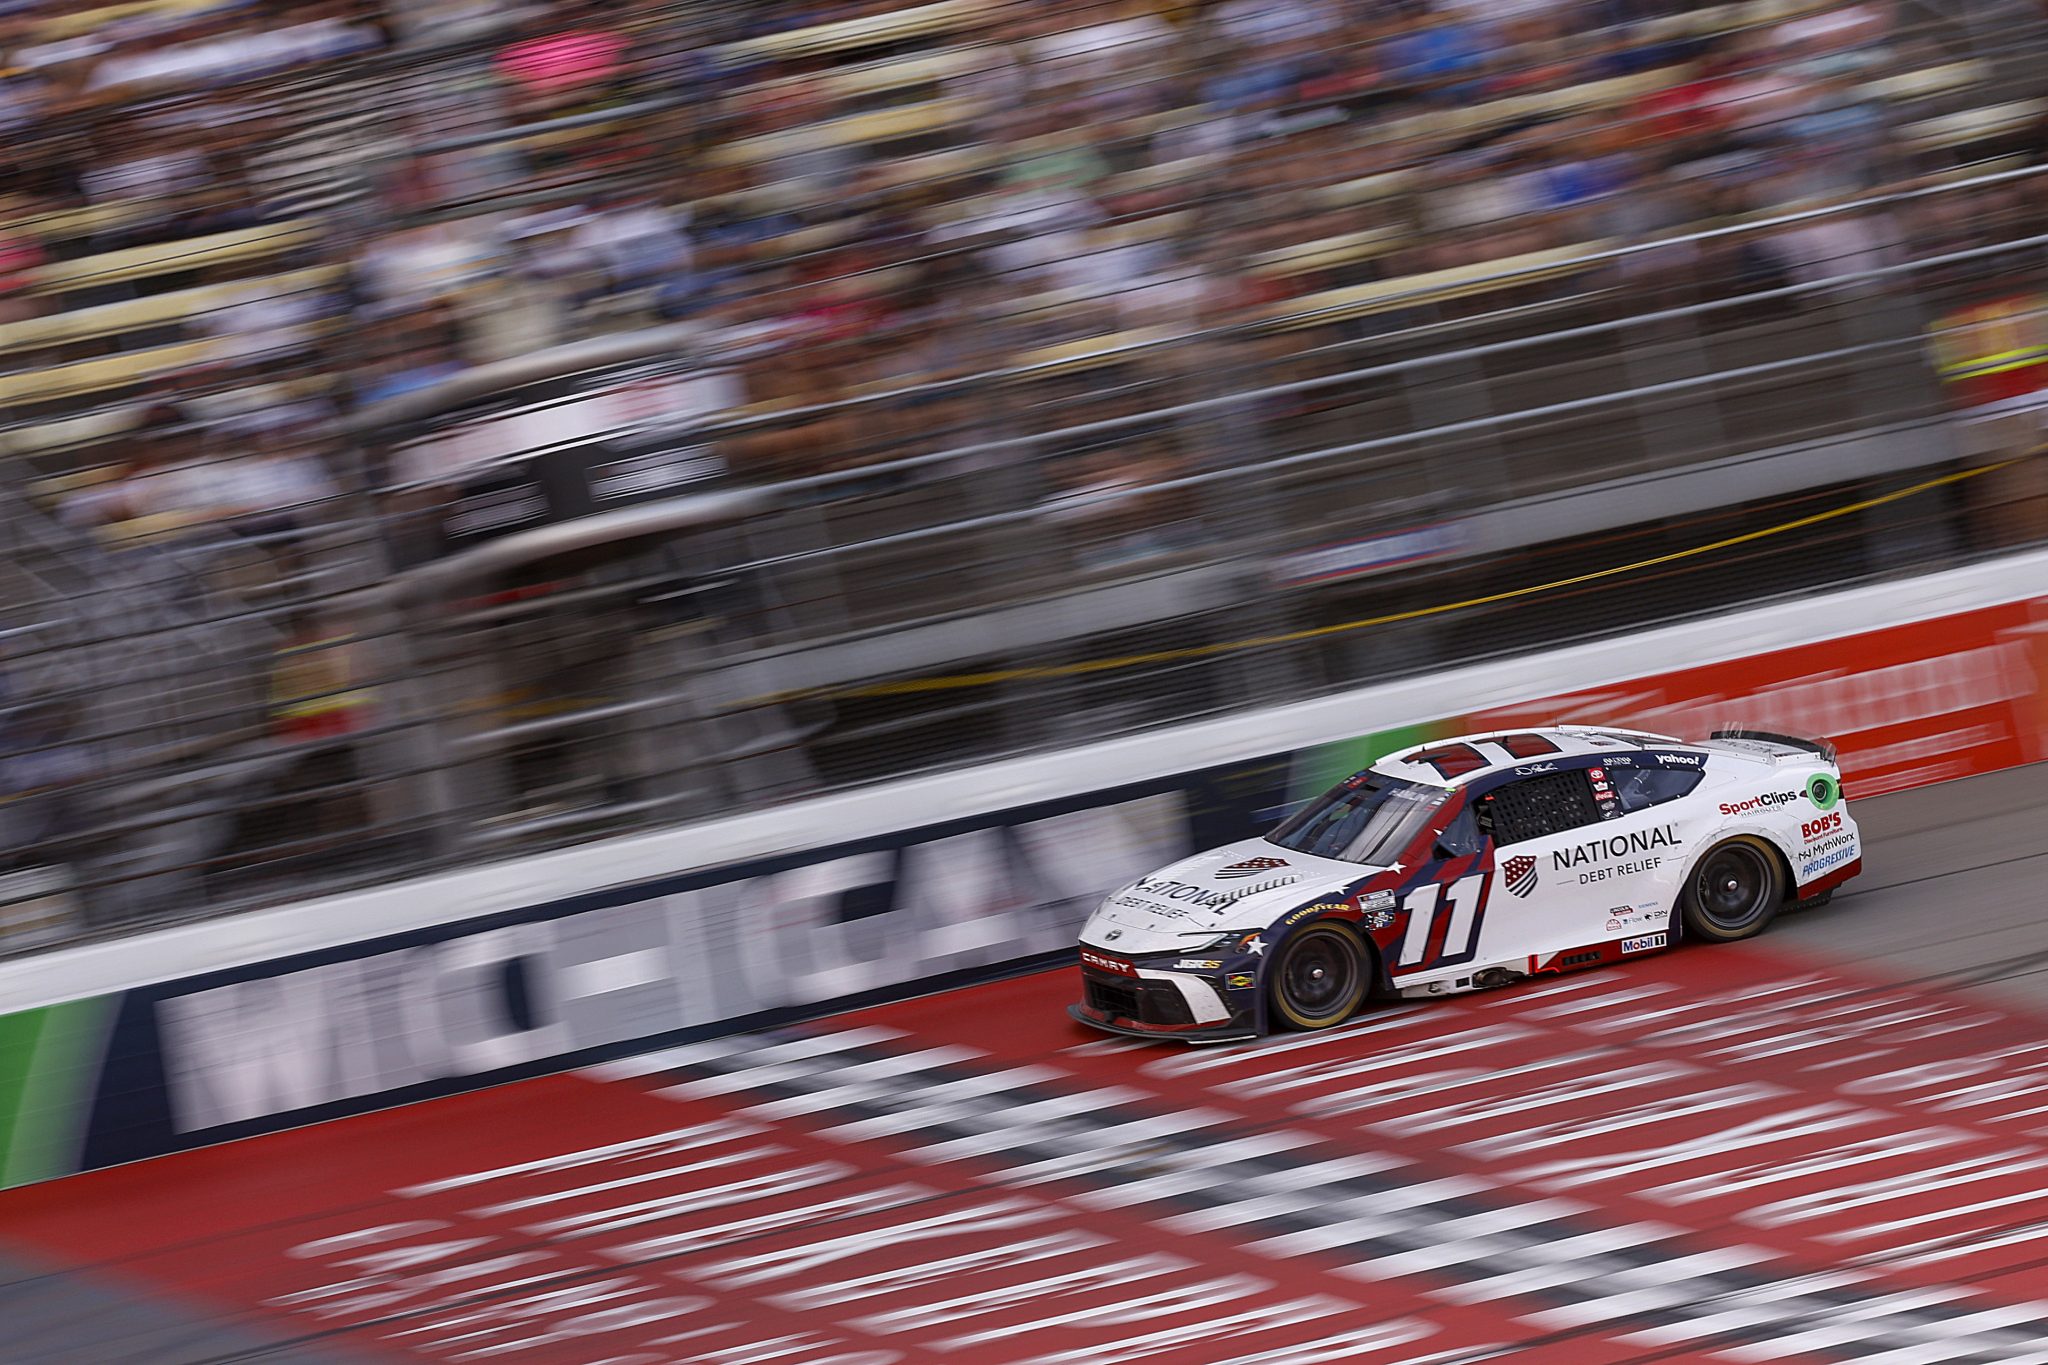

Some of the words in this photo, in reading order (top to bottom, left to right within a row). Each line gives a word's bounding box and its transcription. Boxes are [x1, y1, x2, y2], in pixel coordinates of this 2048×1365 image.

[1655, 753, 1700, 765] yahoo!
[1801, 811, 1842, 839] BOB'S
[1552, 824, 1683, 871] NATIONAL
[1813, 832, 1855, 856] MythWorx
[1579, 867, 1614, 885] DEBT
[1617, 856, 1662, 877] RELIEF
[1802, 844, 1856, 878] PROGRESSIVE
[1398, 873, 1485, 967] 11
[1623, 936, 1653, 952] Mobil
[1656, 935, 1665, 947] 1
[1082, 952, 1131, 973] CAMRY
